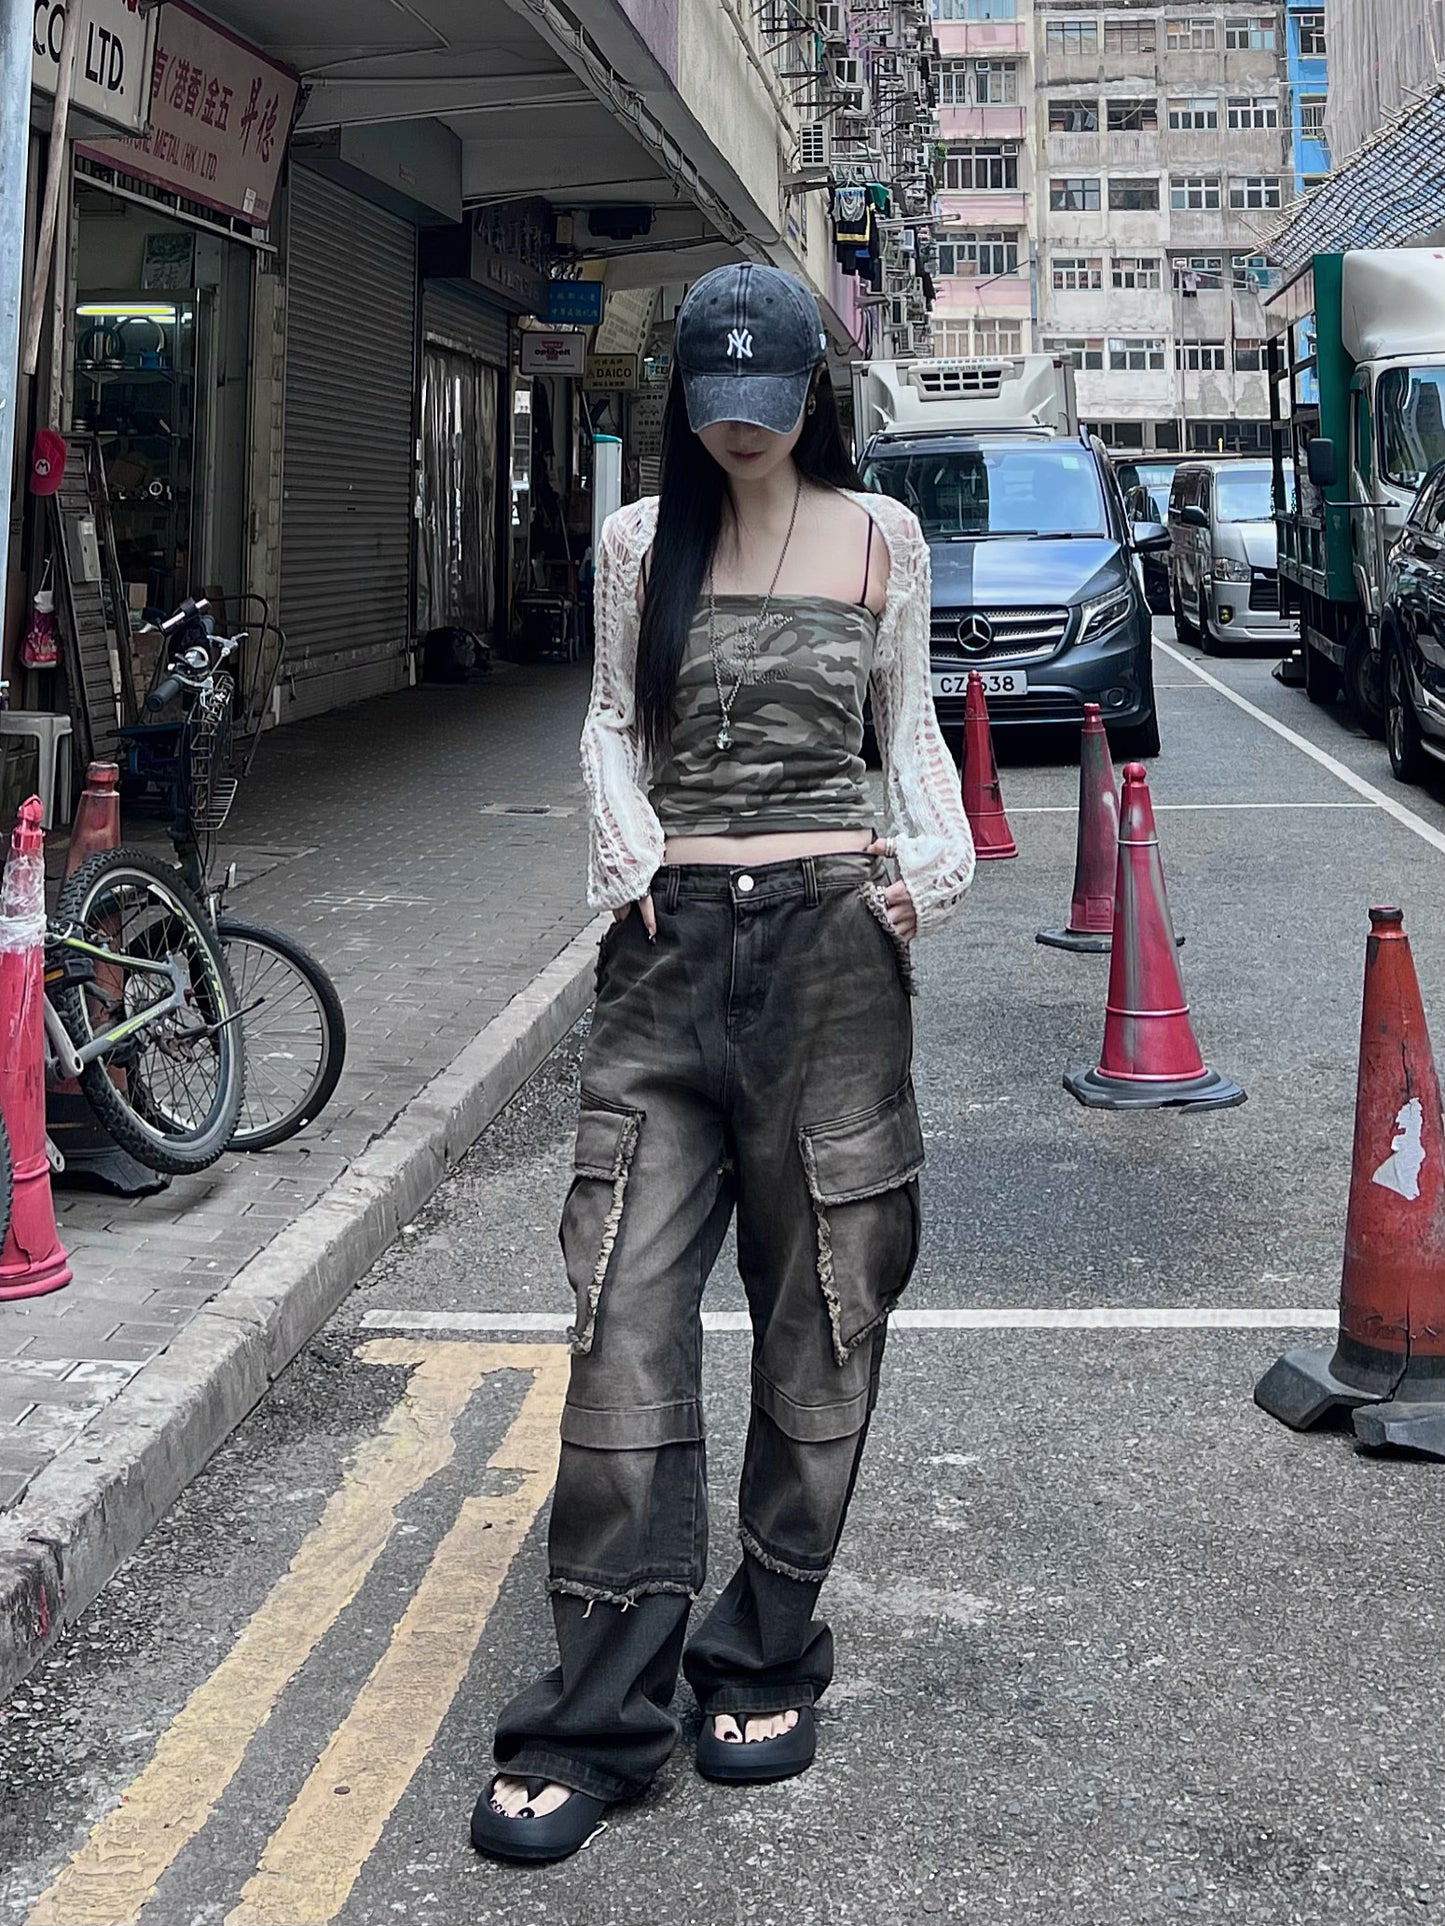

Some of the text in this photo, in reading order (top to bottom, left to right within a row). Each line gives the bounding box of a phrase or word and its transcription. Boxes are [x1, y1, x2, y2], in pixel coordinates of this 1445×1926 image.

[85, 21, 124, 95] LTD.
[153, 128, 180, 166] METAL
[200, 151, 218, 182] LTD.
[726, 328, 753, 359] NY
[596, 367, 632, 378] DAICO
[36, 460, 49, 473] M
